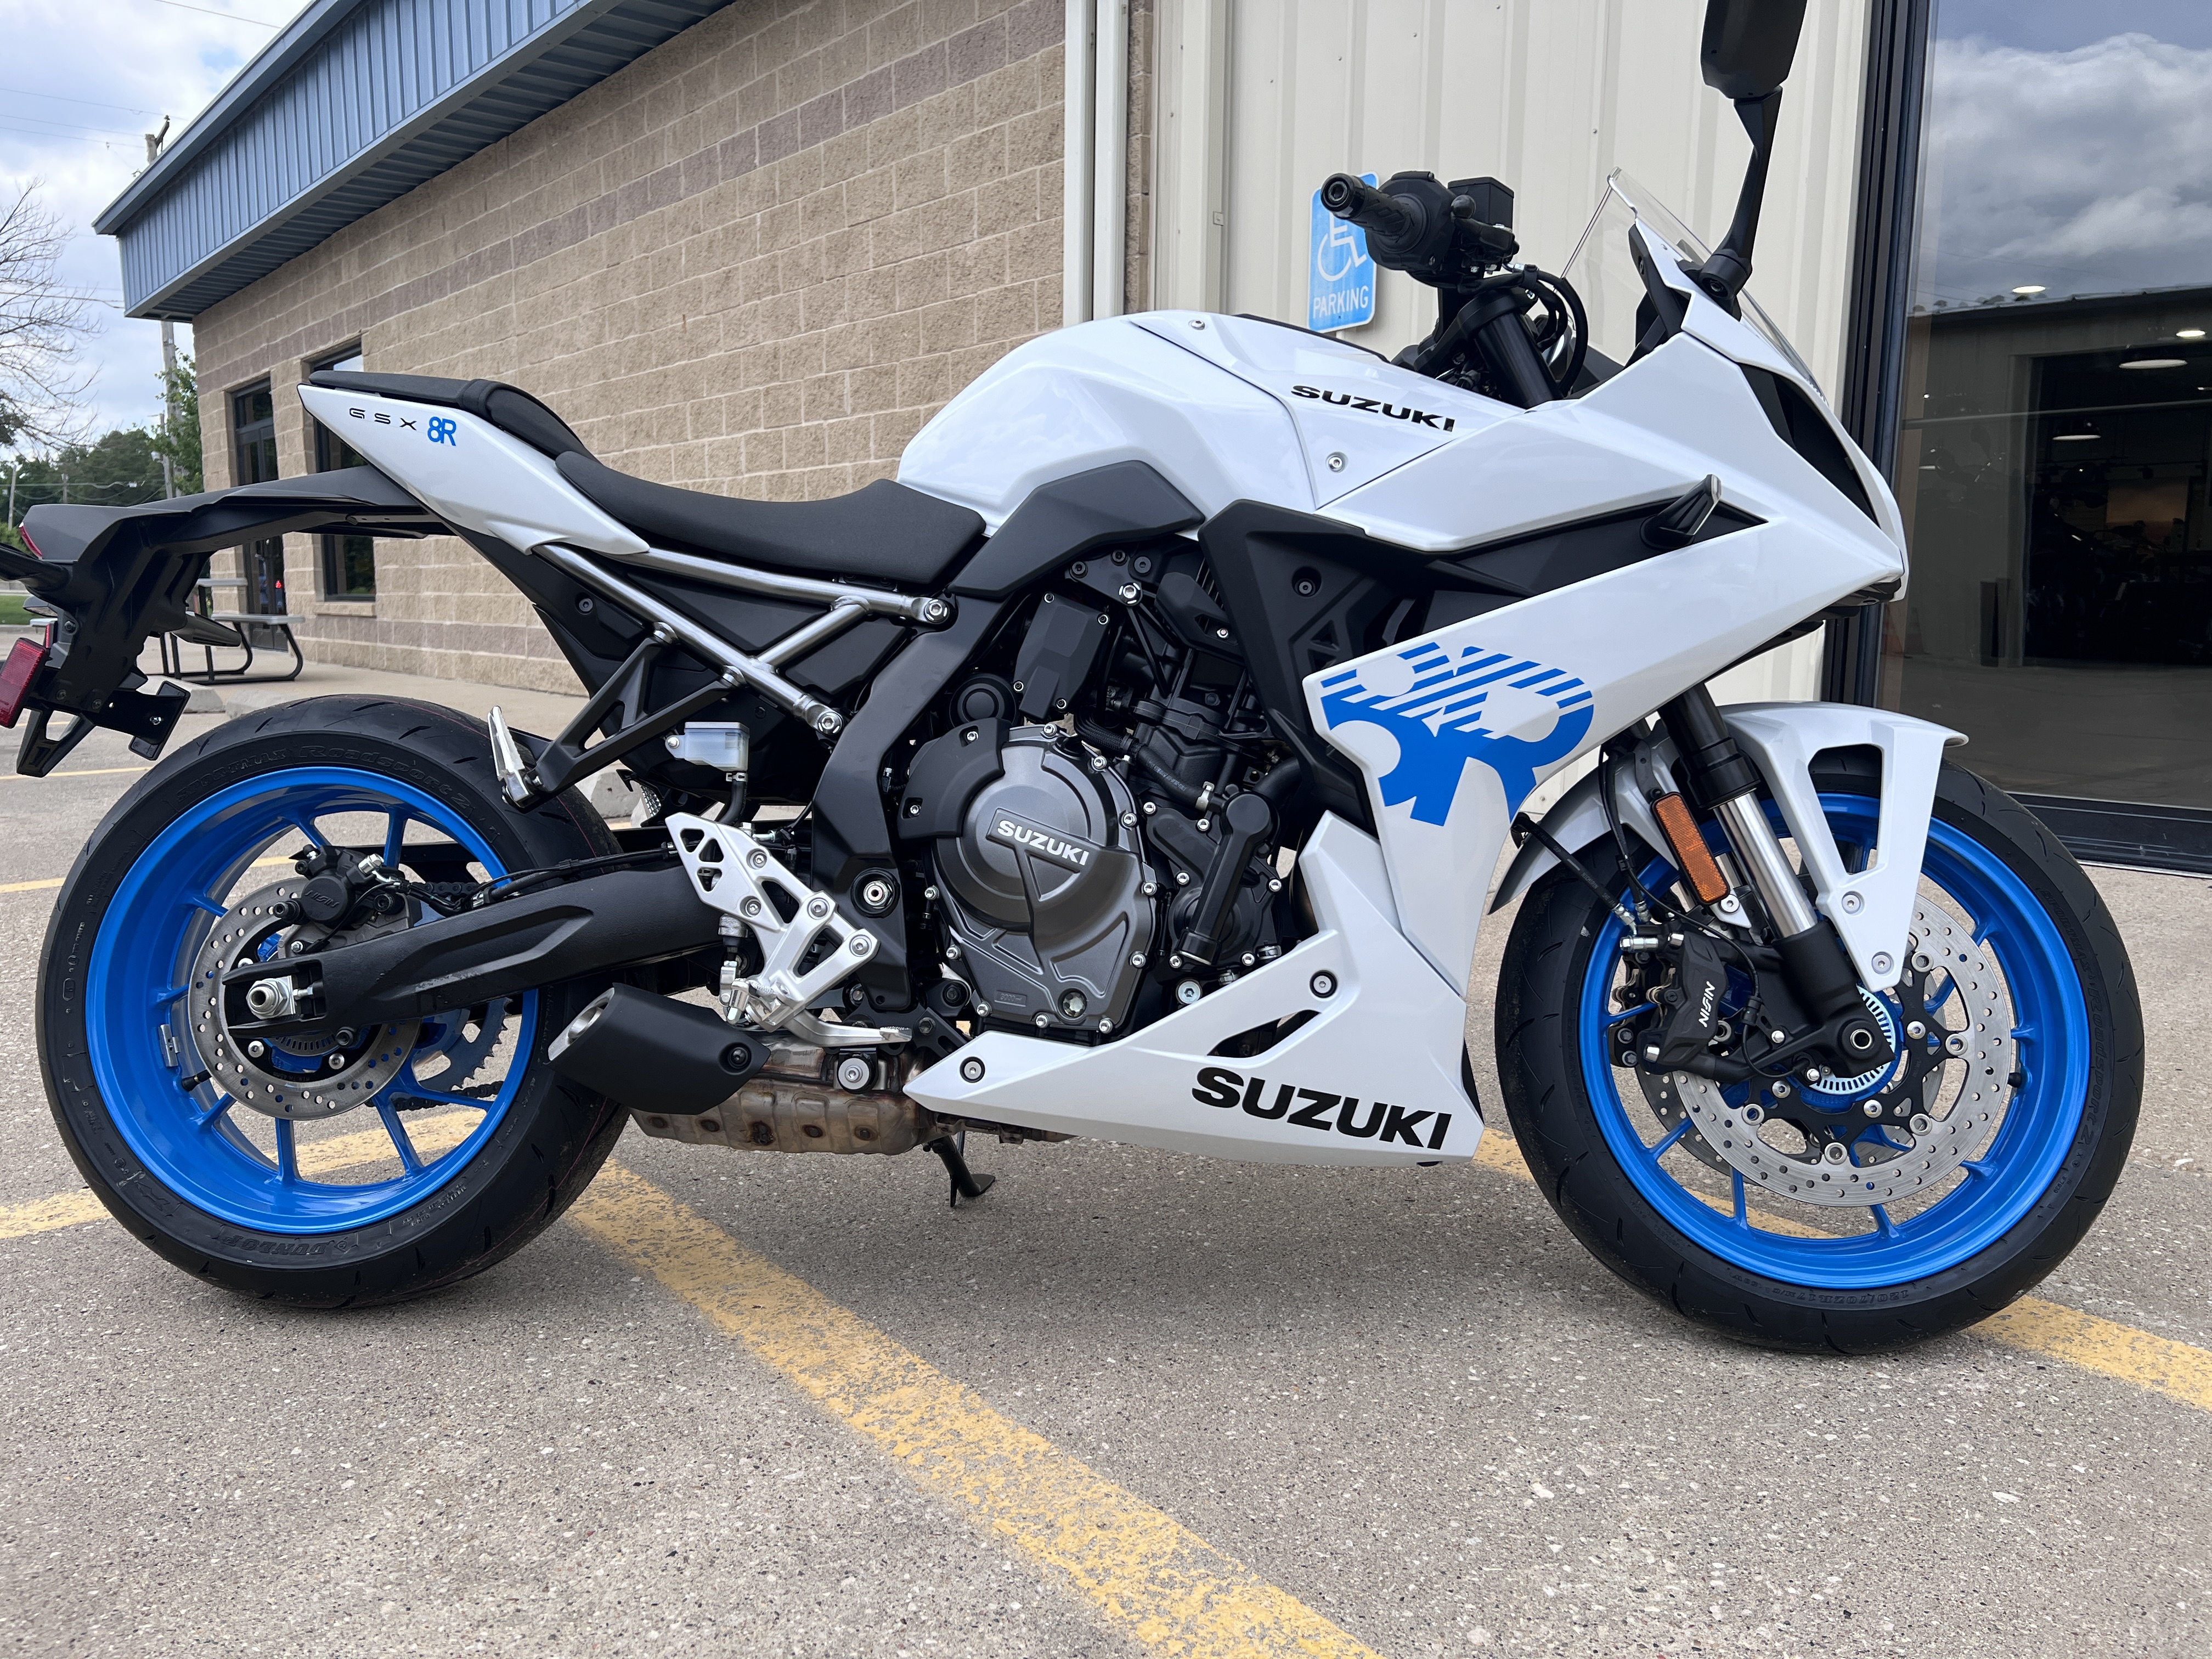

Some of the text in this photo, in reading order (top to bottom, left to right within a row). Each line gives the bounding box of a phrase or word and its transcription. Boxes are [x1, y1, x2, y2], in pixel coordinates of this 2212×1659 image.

[1313, 285, 1369, 319] PARKING
[427, 416, 456, 446] 8R
[1291, 385, 1455, 432] SUZUKI
[299, 746, 449, 793] Roadsport
[996, 820, 1089, 866] SUZUKI
[2042, 888, 2091, 971] SPORTMAX
[2087, 985, 2106, 1125] Roadsport
[1192, 1066, 1452, 1150] SUZUKI
[222, 1235, 328, 1256] DUNLOP
